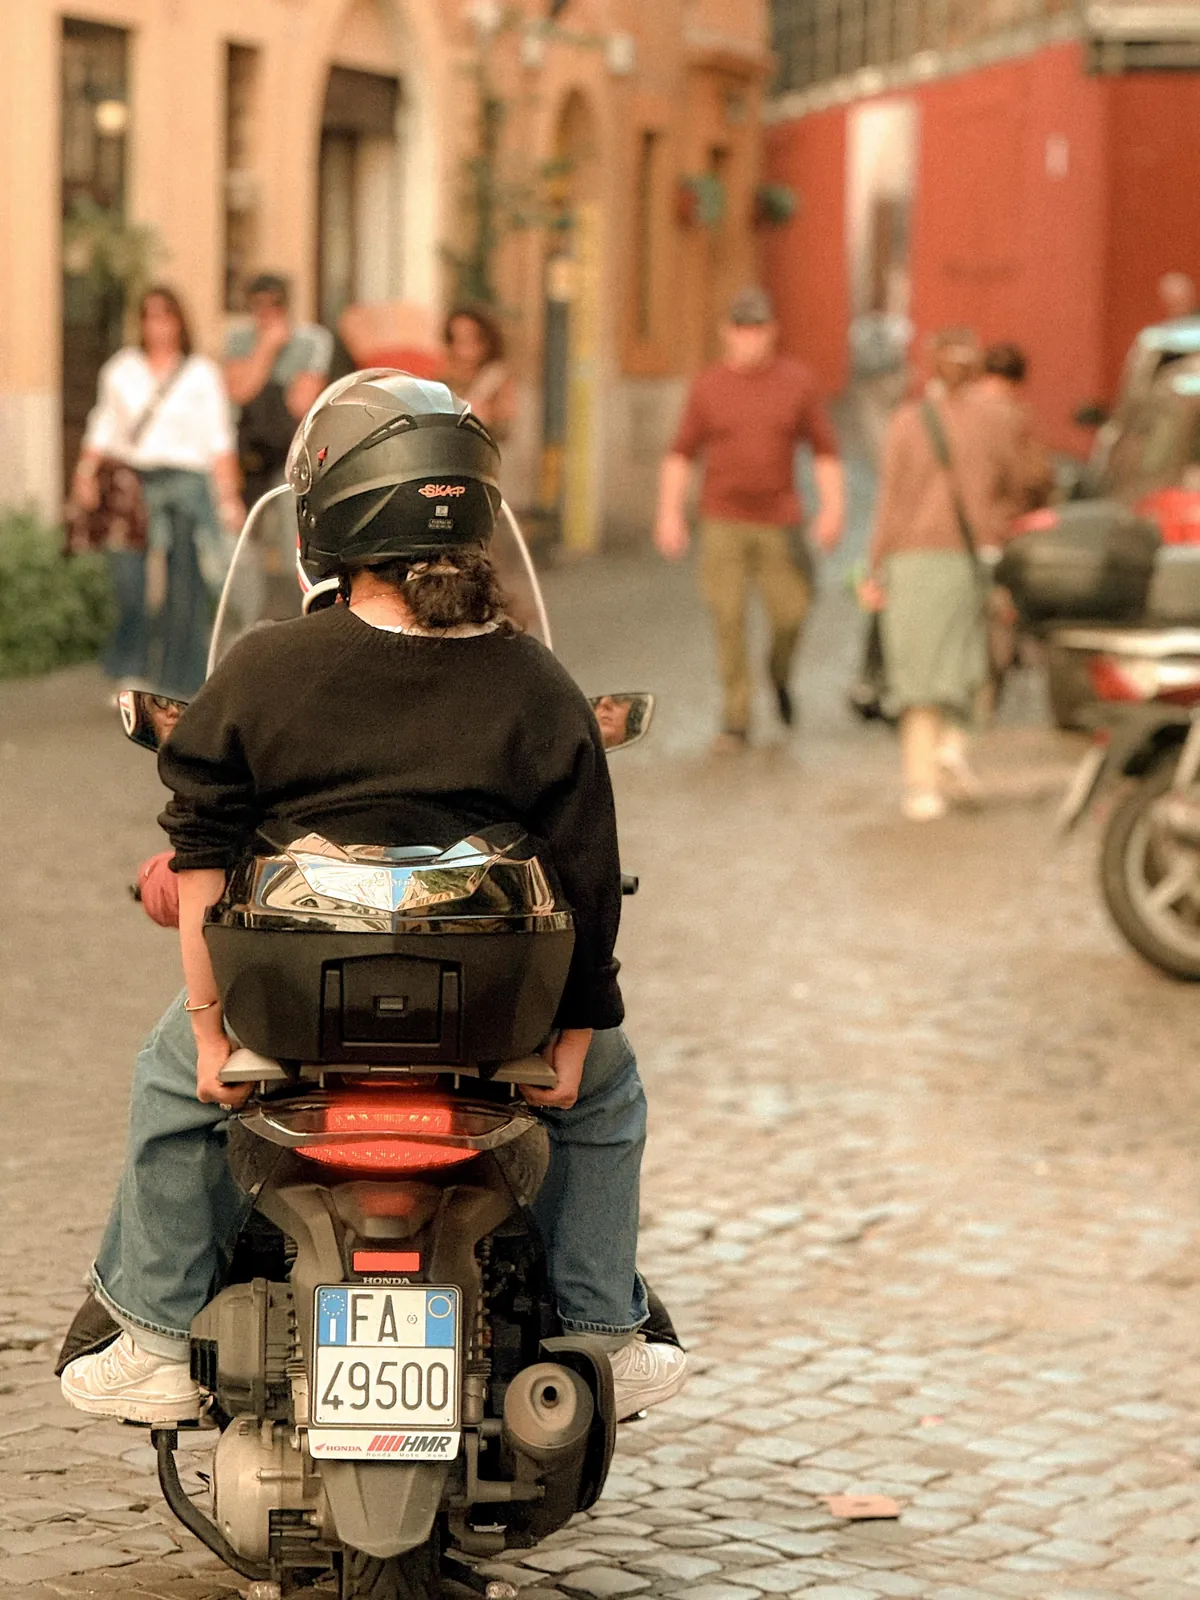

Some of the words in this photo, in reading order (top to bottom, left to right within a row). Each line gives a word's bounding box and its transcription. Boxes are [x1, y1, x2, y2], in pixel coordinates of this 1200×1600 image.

[362, 1277, 411, 1285] HONDA
[351, 1294, 399, 1342] FA
[321, 1361, 449, 1411] 49500
[400, 1435, 452, 1452] HMR
